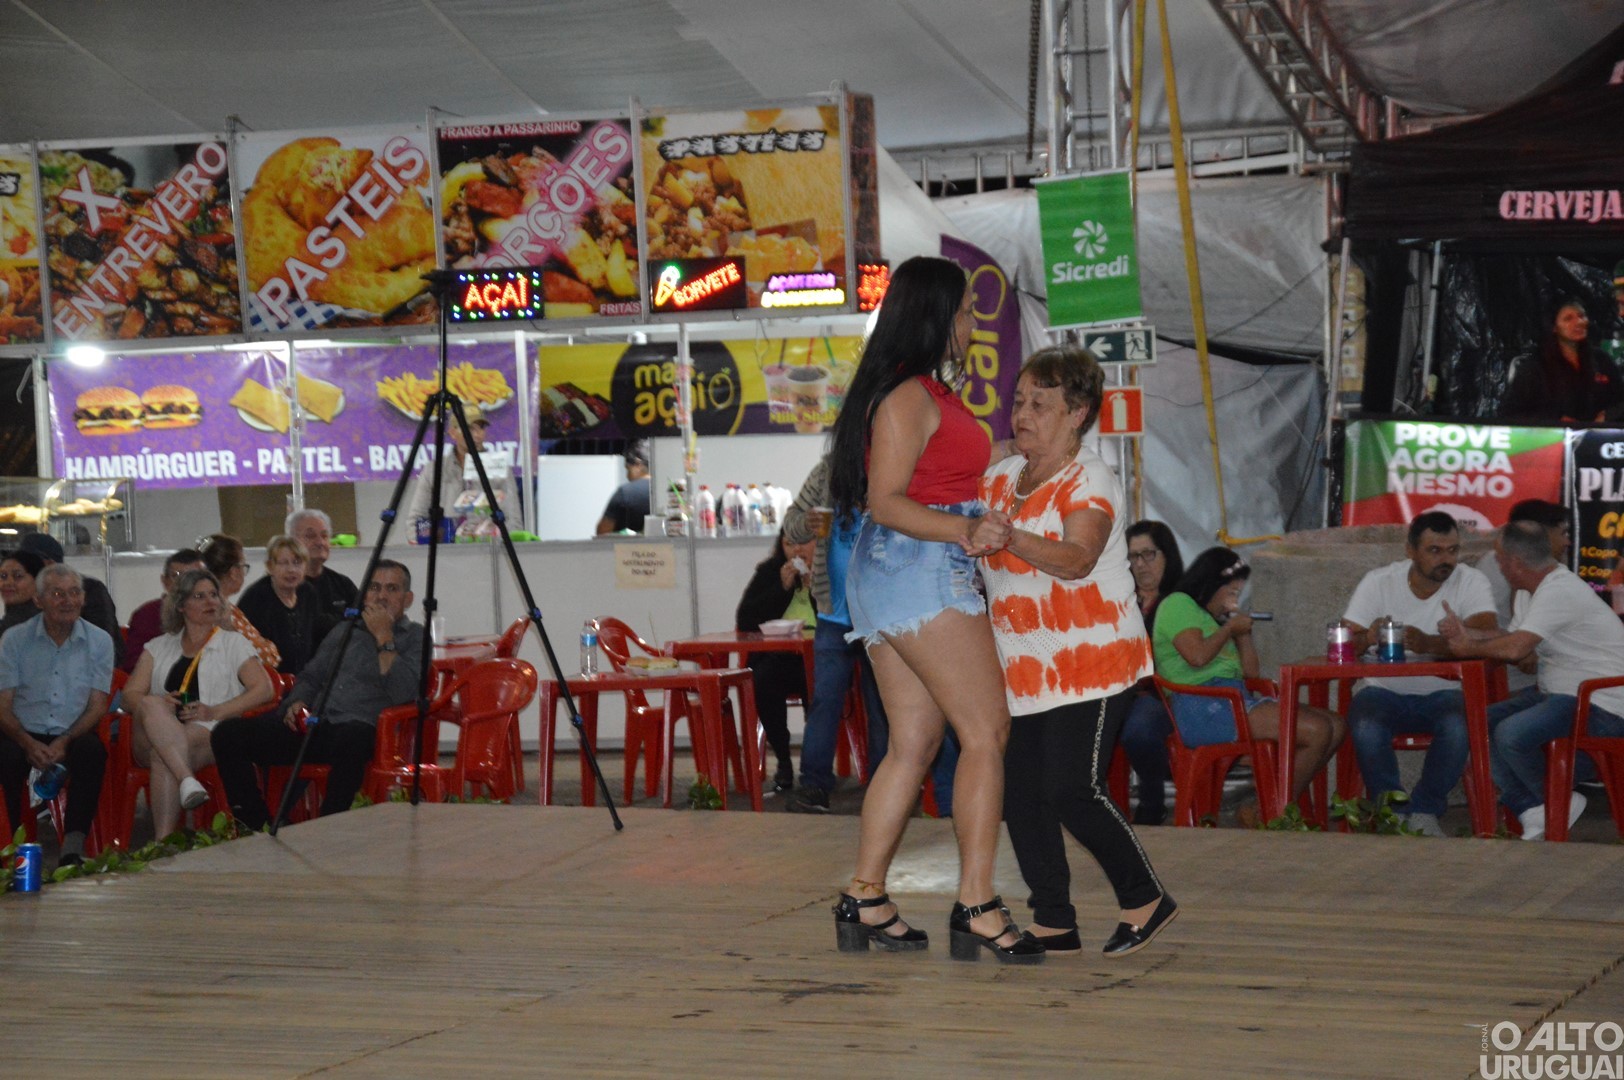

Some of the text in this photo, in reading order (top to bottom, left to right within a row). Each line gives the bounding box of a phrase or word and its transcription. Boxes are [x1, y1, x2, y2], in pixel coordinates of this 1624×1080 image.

[440, 125, 490, 138] FRANGO
[504, 120, 581, 136] PASSARINHO
[59, 165, 120, 233] X
[51, 141, 227, 341] ENTREVERO
[256, 136, 426, 323] PASTEIS
[672, 263, 741, 307] SORVETE
[1052, 255, 1129, 284] Sicredi
[1394, 422, 1511, 449] PROVE
[64, 447, 237, 480] HAMBÚRGUER
[257, 446, 347, 475] PATEL
[1388, 447, 1513, 473] AGORA
[1386, 470, 1513, 498] MESMO
